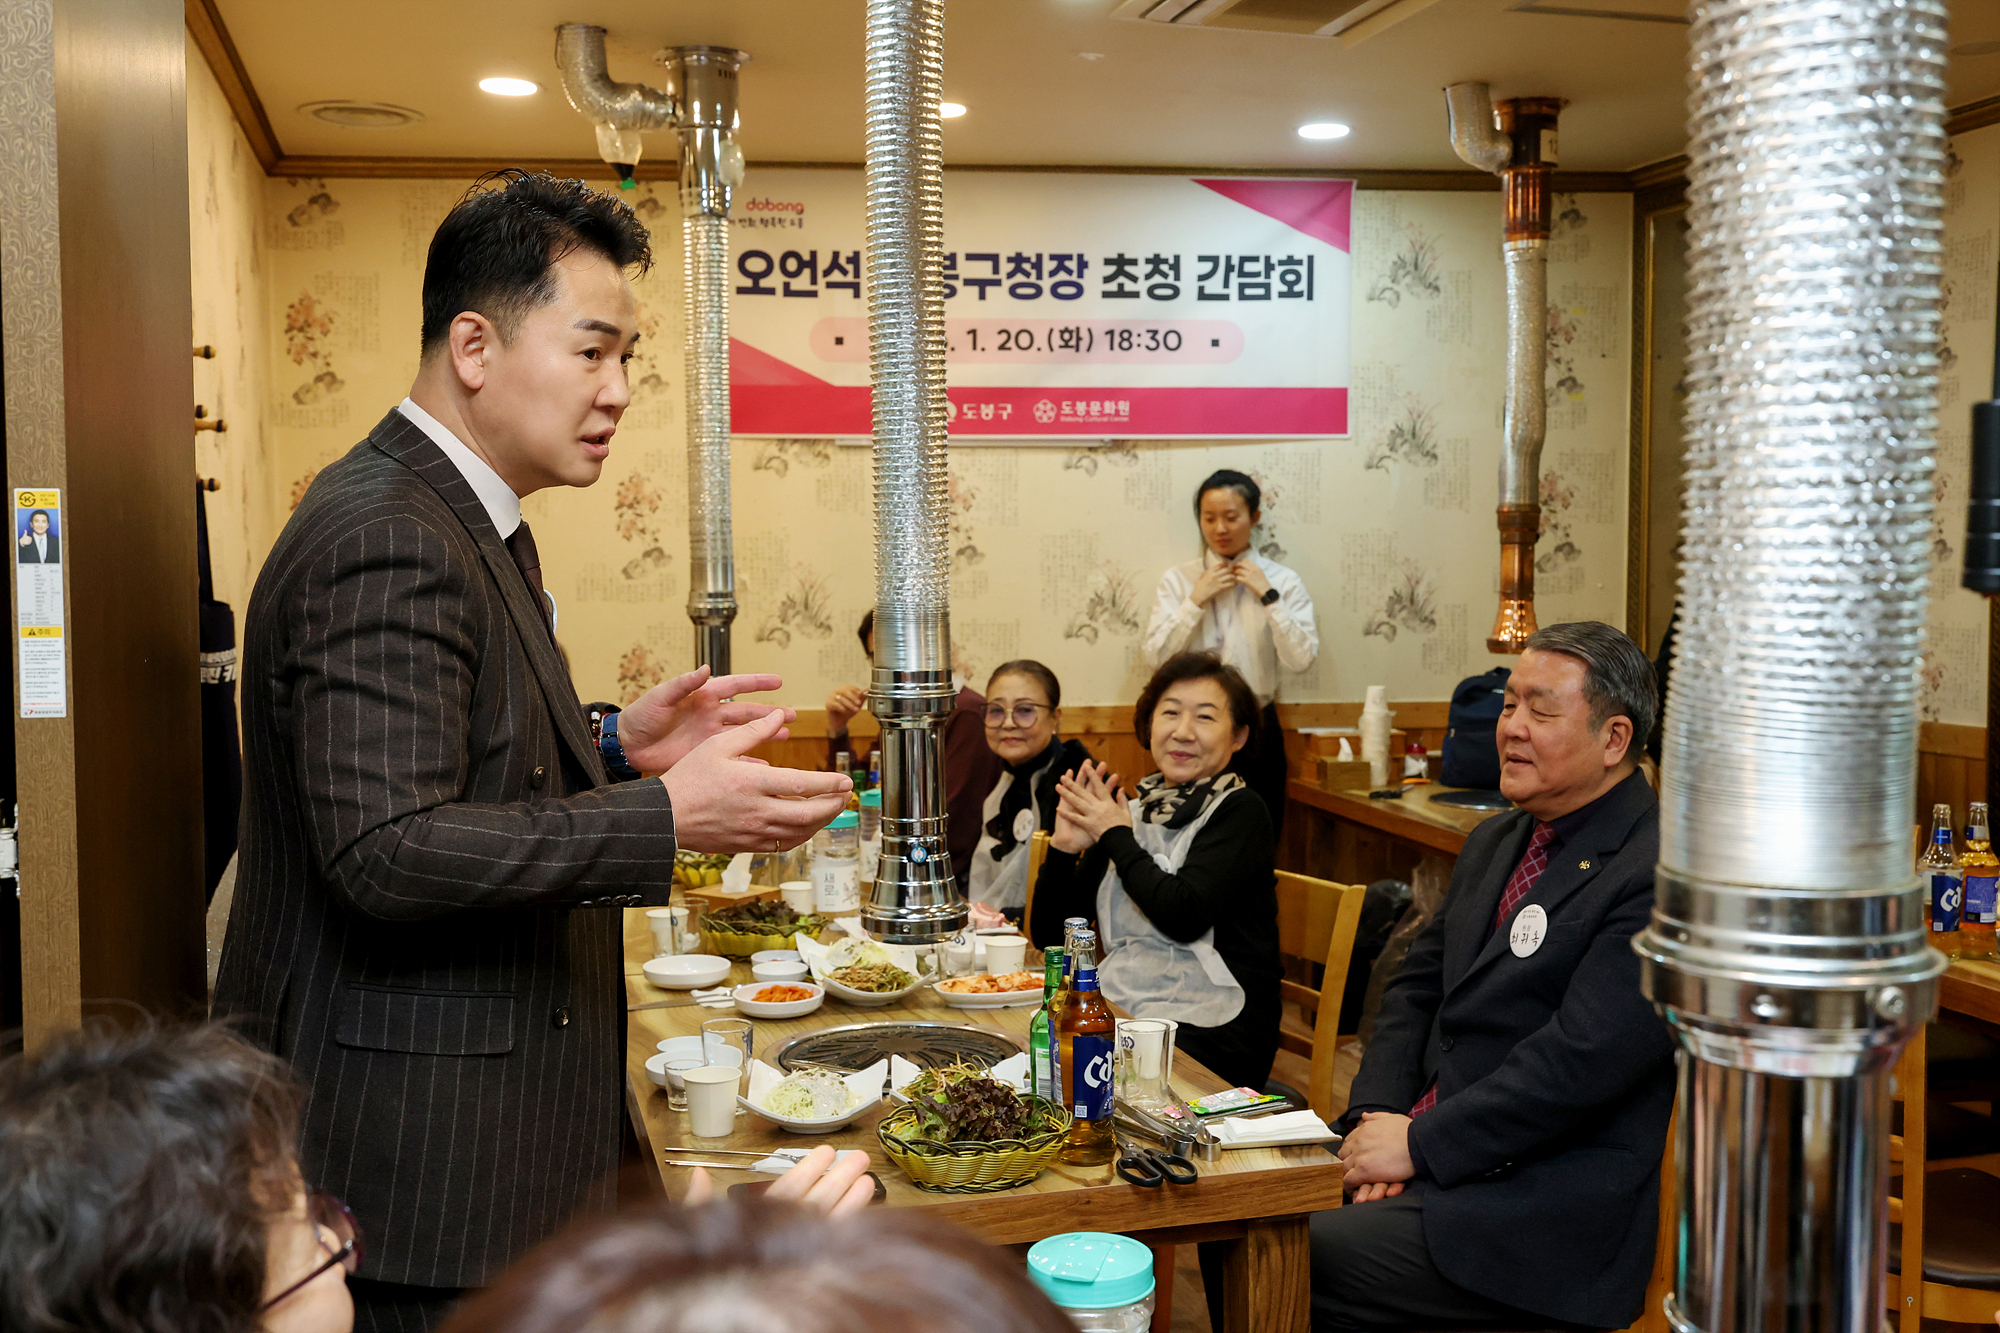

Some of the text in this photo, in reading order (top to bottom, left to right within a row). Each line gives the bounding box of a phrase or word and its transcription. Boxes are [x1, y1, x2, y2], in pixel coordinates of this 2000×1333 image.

[745, 197, 804, 215] dobong
[736, 249, 1314, 301] 오언석 구청장 초청 간담회
[966, 329, 985, 352] 1.
[1104, 329, 1182, 351] 18:30
[962, 403, 1012, 421] 도봉구
[1060, 400, 1130, 416] 도봉문화원
